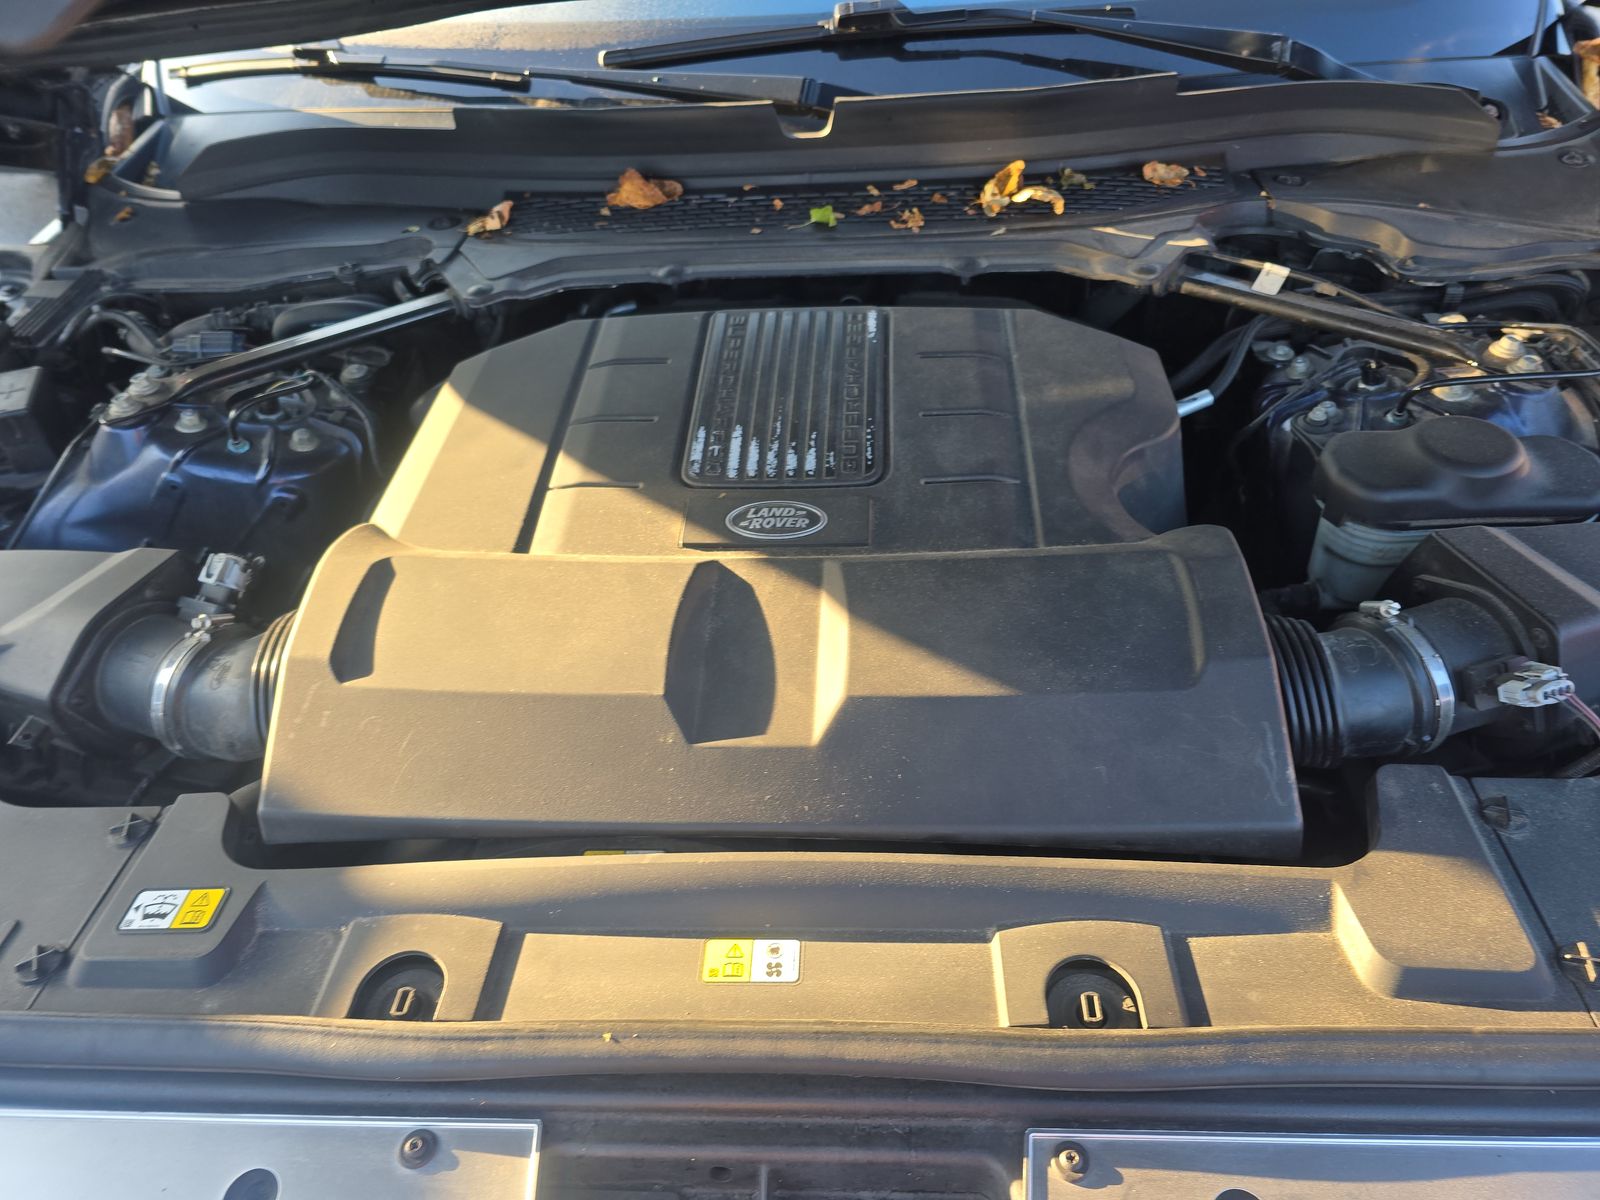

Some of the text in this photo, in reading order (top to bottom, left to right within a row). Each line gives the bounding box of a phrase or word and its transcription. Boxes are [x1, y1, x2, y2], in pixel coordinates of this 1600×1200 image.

[841, 313, 865, 474] SUPERCHARGED
[746, 507, 796, 519] LAND
[748, 517, 810, 529] ROVER
